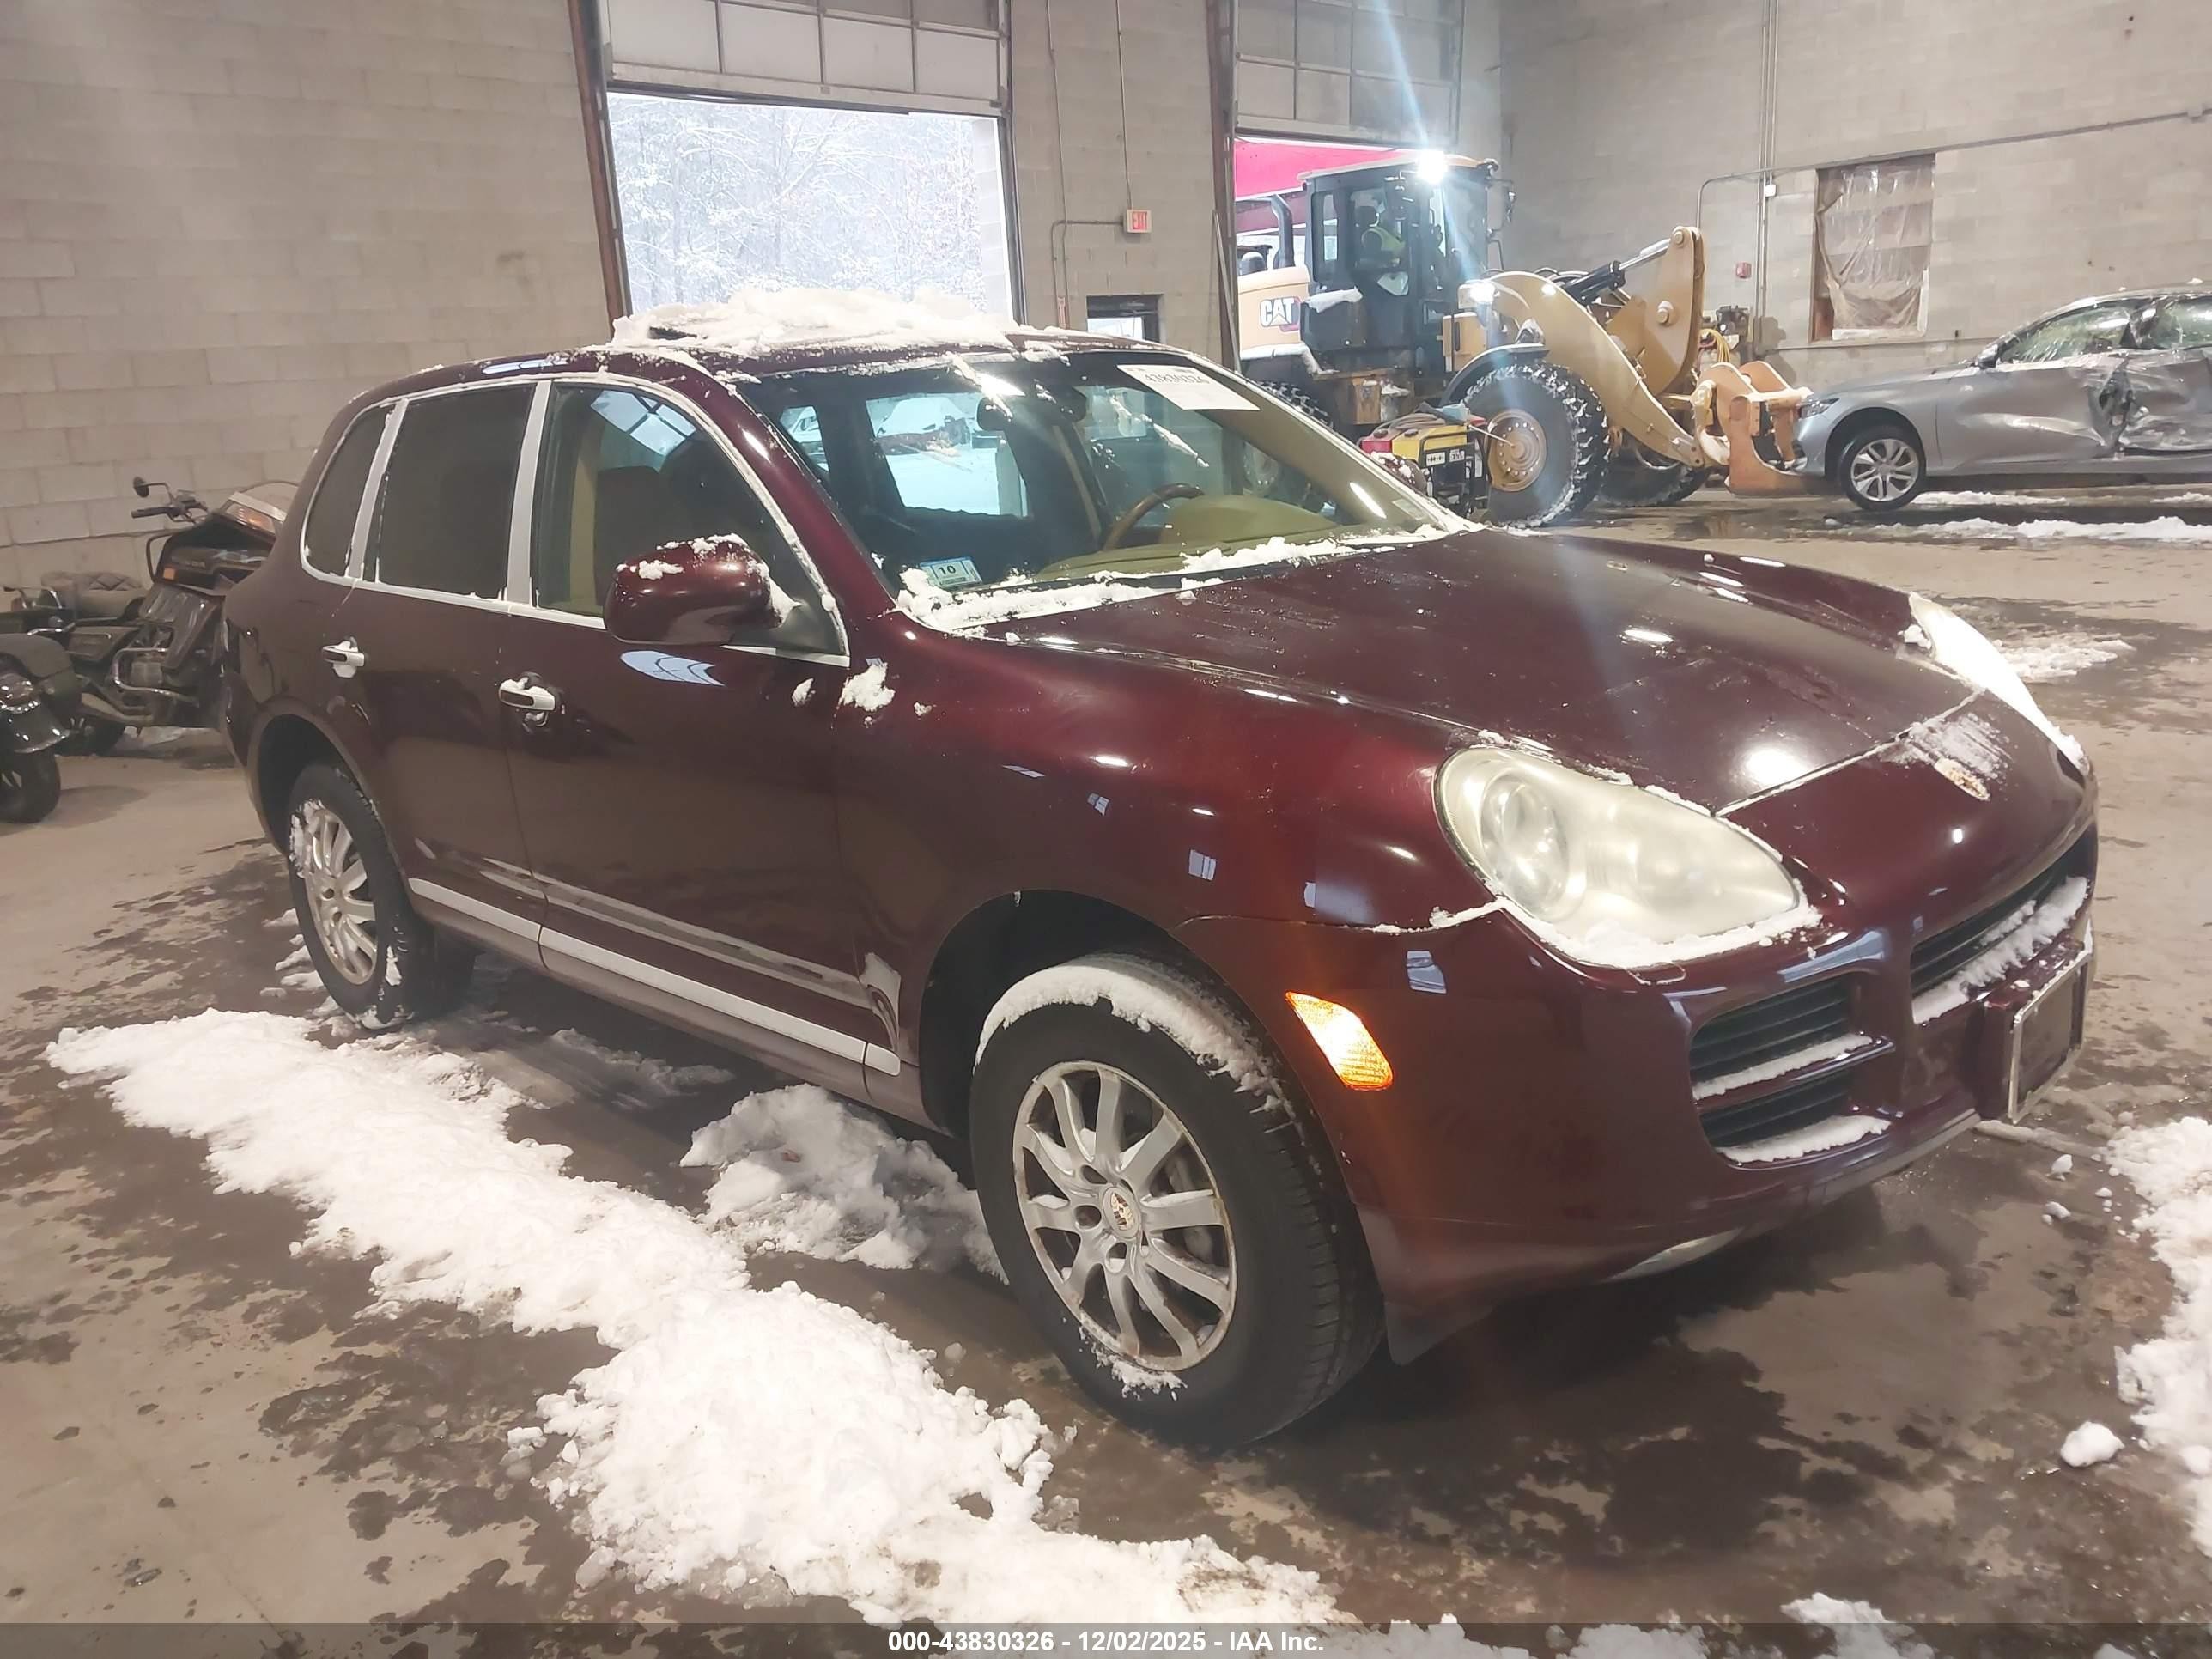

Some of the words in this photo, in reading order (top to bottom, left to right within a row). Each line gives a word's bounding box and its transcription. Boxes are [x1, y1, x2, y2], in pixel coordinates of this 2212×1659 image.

[1132, 211, 1148, 230] EXIT
[1260, 297, 1295, 327] CAT
[939, 565, 957, 575] 10
